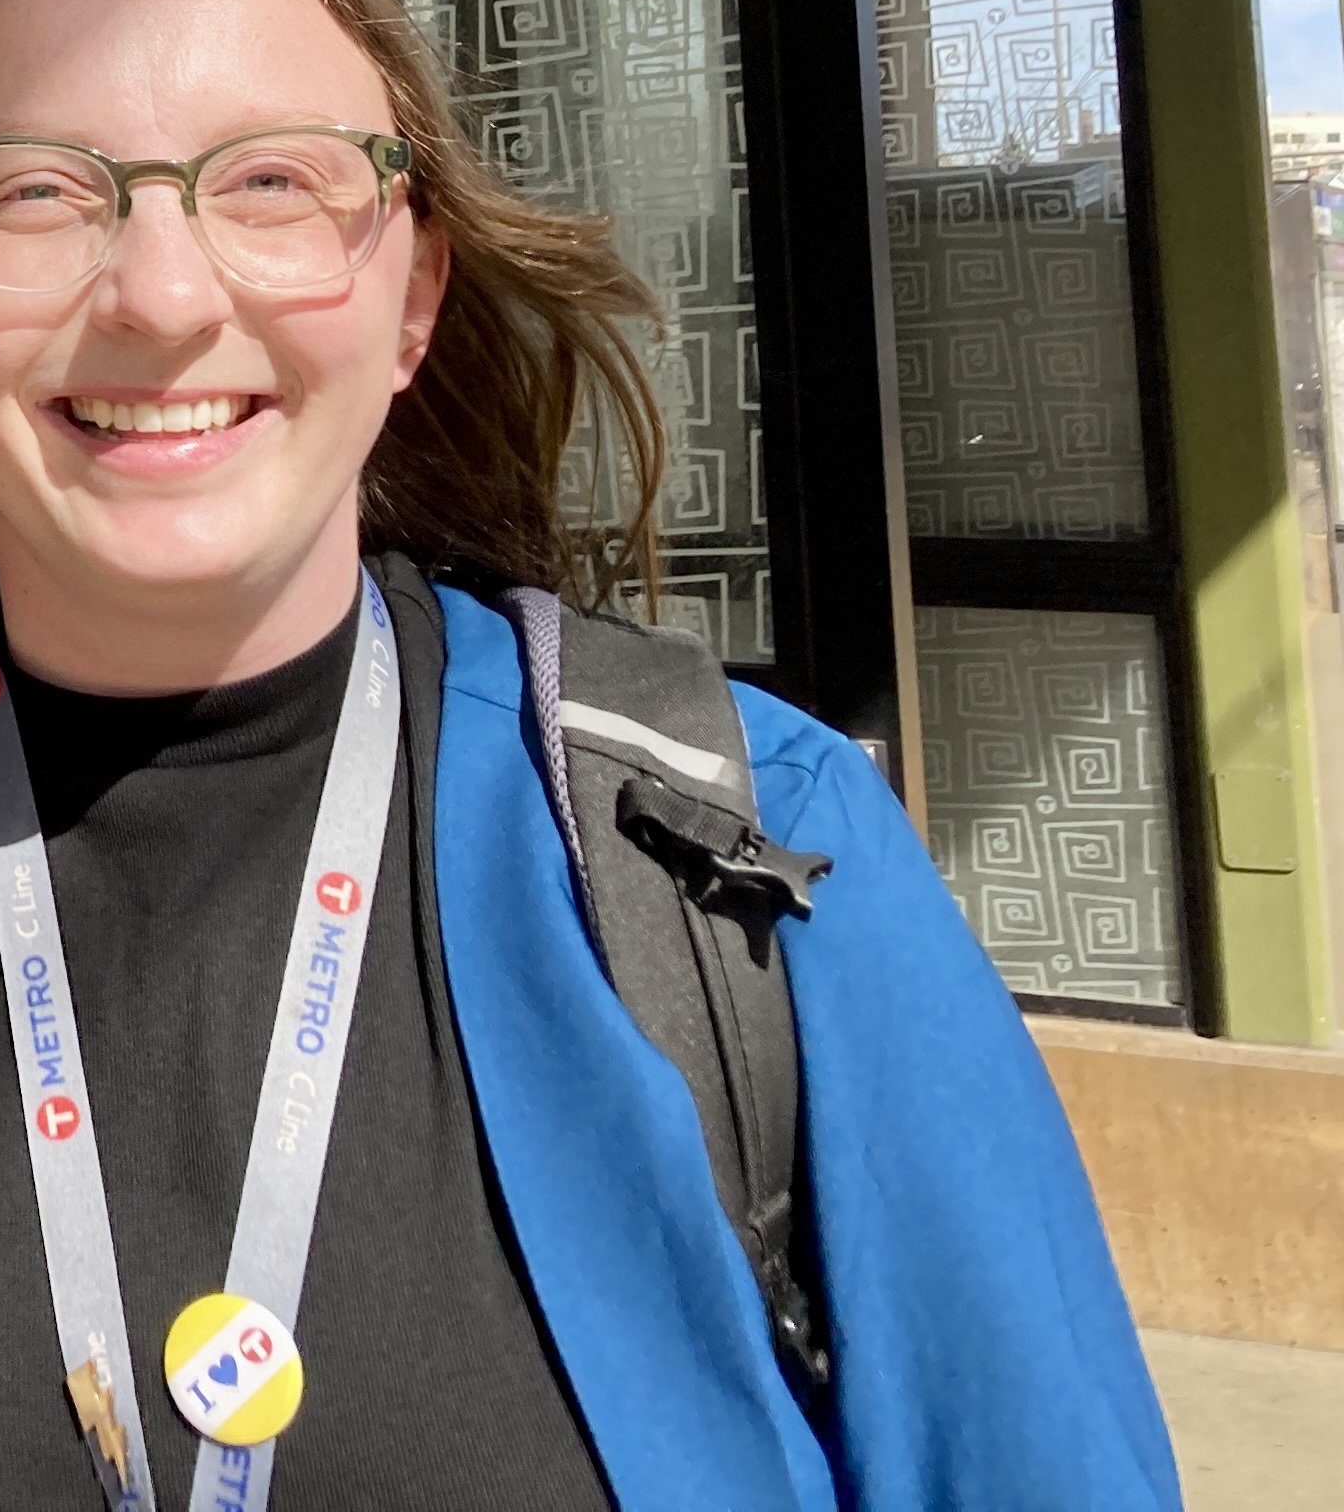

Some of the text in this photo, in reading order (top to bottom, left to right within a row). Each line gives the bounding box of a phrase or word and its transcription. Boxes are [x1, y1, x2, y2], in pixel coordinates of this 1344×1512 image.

[372, 639, 389, 662] C
[366, 659, 389, 708] Line
[12, 862, 37, 913] Line
[15, 920, 40, 939] C
[295, 921, 347, 1057] METRO
[21, 954, 66, 1088] METRO
[288, 1071, 316, 1098] C
[276, 1096, 311, 1155] Line
[186, 1379, 216, 1414] I
